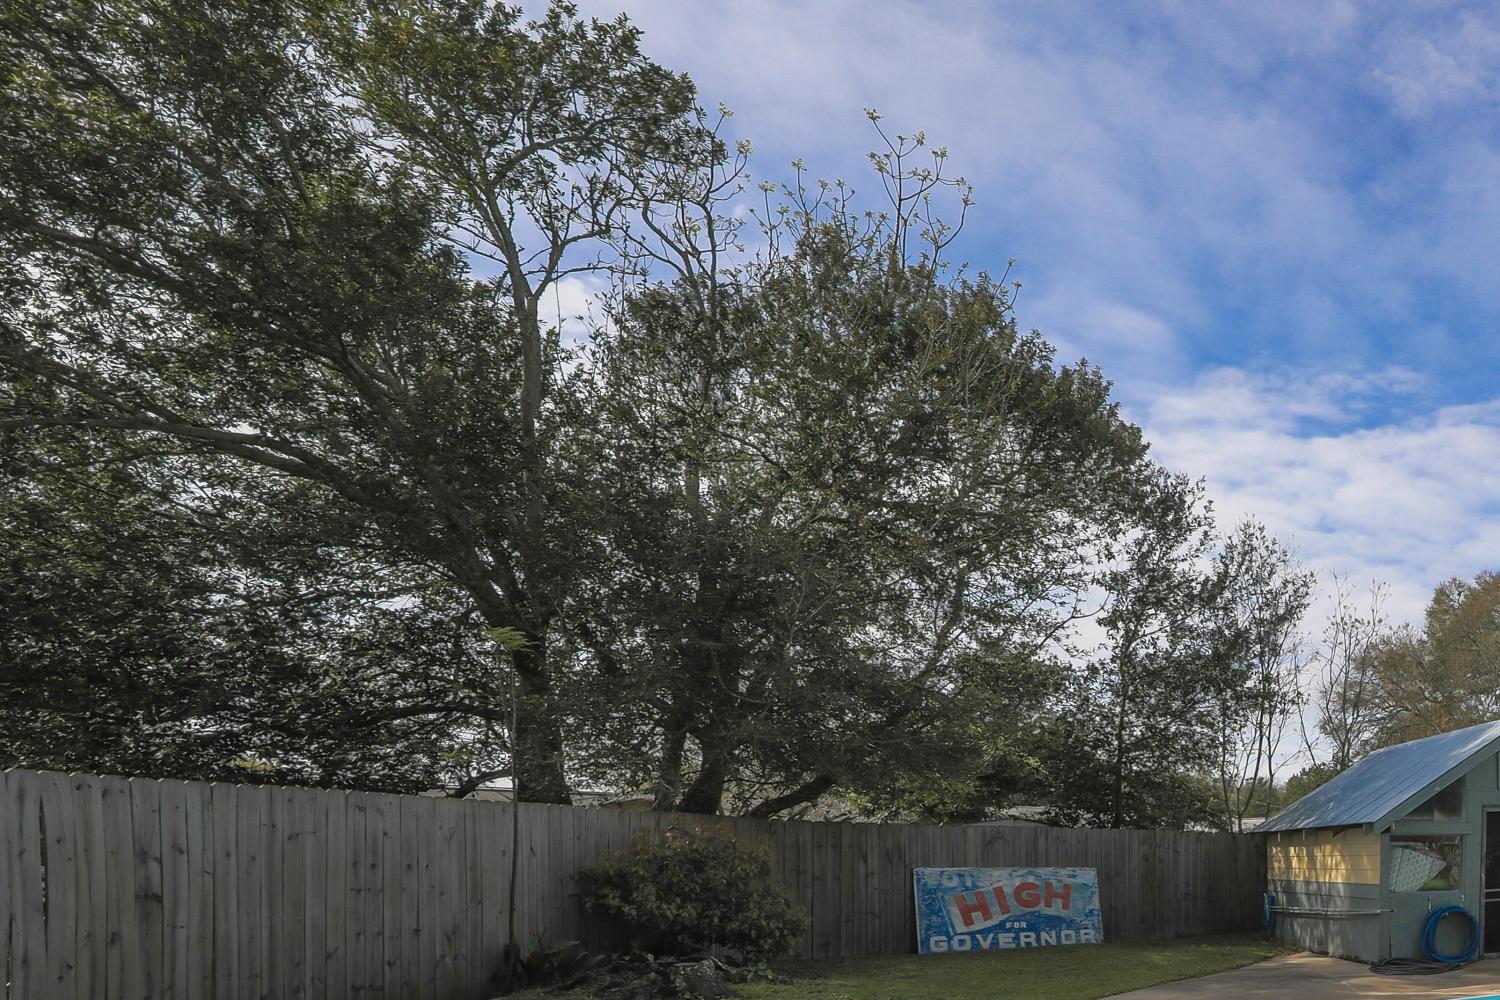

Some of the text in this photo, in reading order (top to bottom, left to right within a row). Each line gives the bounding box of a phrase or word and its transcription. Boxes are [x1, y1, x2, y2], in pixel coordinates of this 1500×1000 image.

[955, 881, 1072, 927] HIGH
[1005, 921, 1027, 929] FOR
[930, 929, 1098, 952] GOVERNOR
